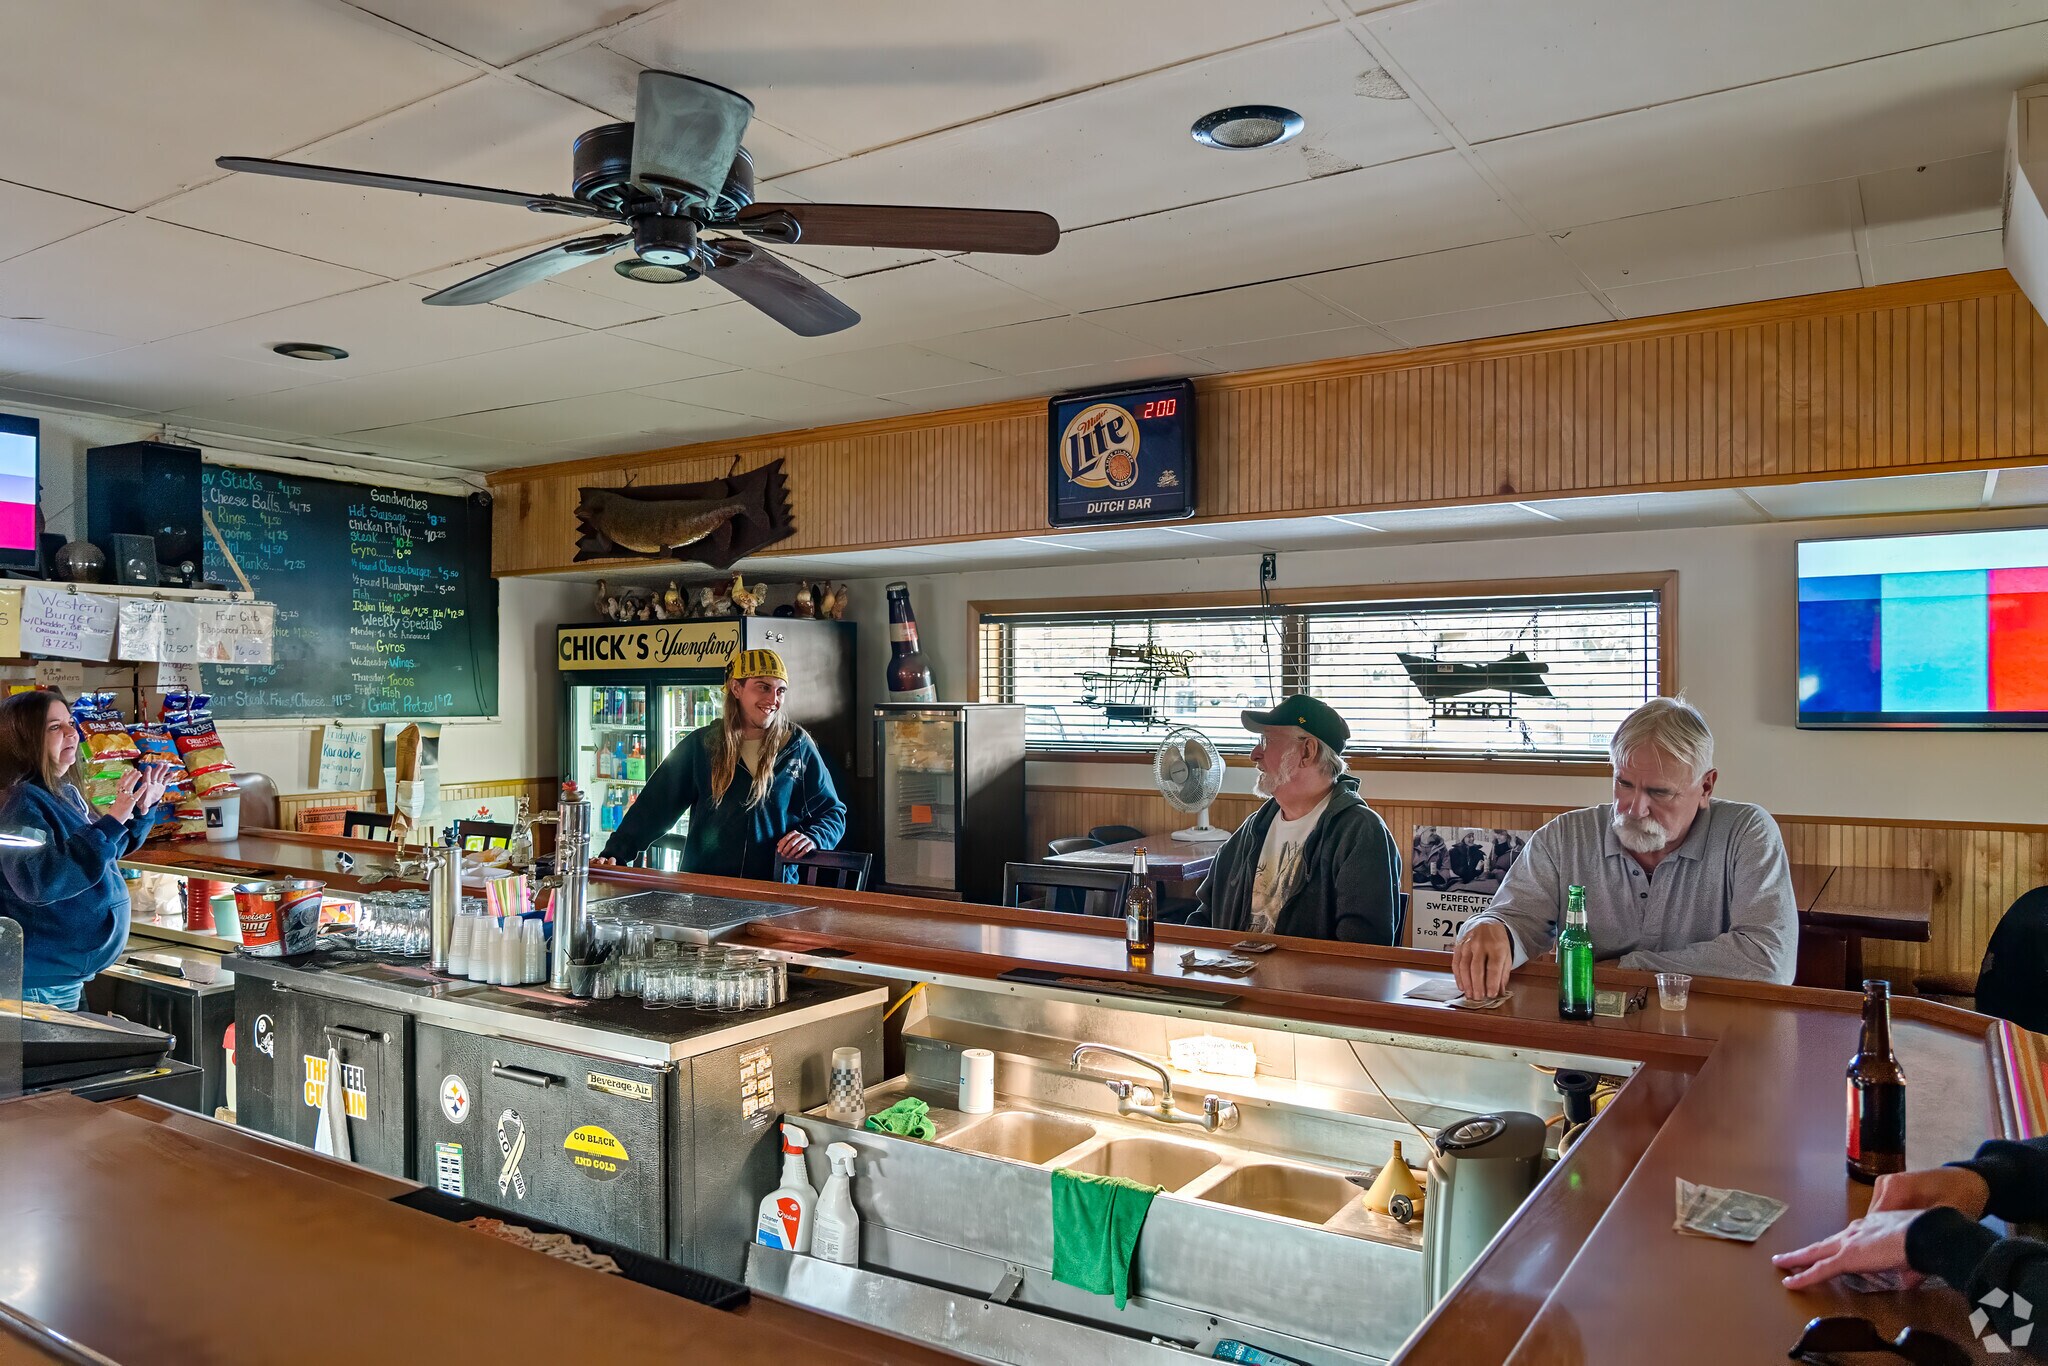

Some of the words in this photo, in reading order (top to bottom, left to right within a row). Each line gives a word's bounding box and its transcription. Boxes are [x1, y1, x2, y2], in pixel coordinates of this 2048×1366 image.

[1077, 409, 1108, 434] Miller
[1068, 415, 1130, 482] Lite
[202, 473, 214, 485] ov
[220, 470, 262, 491] Sticks
[211, 487, 249, 507] Cheese
[252, 494, 280, 512] Balls
[371, 489, 428, 510] Sandwiches
[1087, 501, 1125, 514] DUTCH
[1127, 498, 1152, 511] BAR
[217, 506, 247, 529] Rings
[348, 504, 367, 518] Hot
[370, 506, 408, 524] Sausage
[348, 519, 383, 533] Chicken
[385, 522, 411, 541] Philly
[350, 531, 378, 543] Steak
[351, 543, 376, 558] Gyro
[203, 570, 217, 581] es
[379, 559, 431, 580] Cheeseburger
[353, 588, 370, 600] Fish
[382, 576, 425, 597] Hamburger
[37, 590, 103, 614] Western
[45, 606, 95, 625] Burger
[215, 610, 236, 621] Four
[240, 610, 260, 622] Cut
[361, 614, 400, 631] Weekly
[402, 616, 443, 632] Specials
[376, 639, 406, 654] Gyros
[560, 633, 649, 661] CHICK'S
[654, 628, 740, 663] Yuengling
[388, 656, 416, 672] Wings
[387, 673, 415, 687] Tacos
[382, 687, 401, 699] Fish
[403, 695, 438, 713] Pretzel
[323, 743, 361, 759] Karaoke
[1441, 894, 1479, 904] PERFECT
[1427, 903, 1468, 913] SWEATER
[240, 921, 270, 933] cing
[498, 1128, 510, 1152] GO
[573, 1132, 585, 1142] GO
[587, 1133, 615, 1148] BLACK
[574, 1156, 592, 1168] AND
[592, 1159, 617, 1172] GOLD
[513, 1173, 525, 1195] PENS
[761, 1213, 779, 1223] Cleaner
